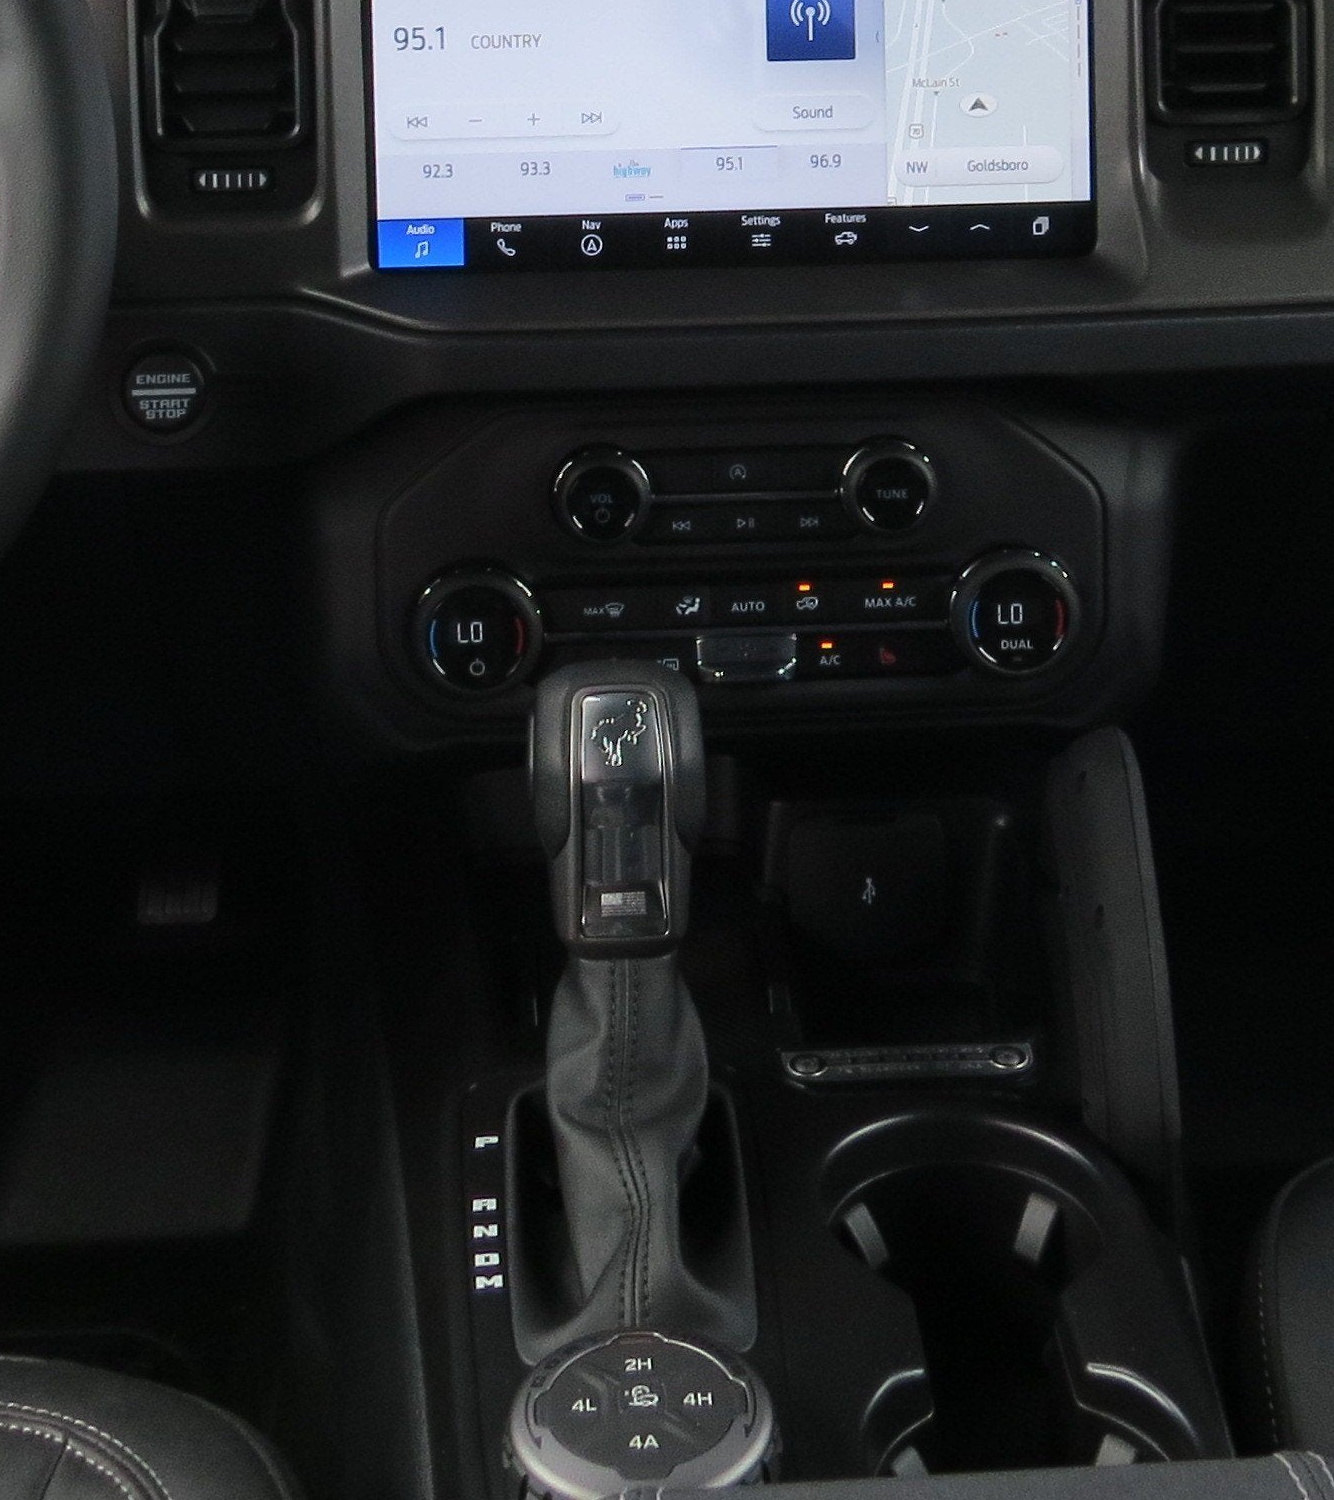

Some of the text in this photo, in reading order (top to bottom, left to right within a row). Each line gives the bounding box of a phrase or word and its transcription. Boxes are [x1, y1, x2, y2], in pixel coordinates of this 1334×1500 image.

[393, 25, 542, 52] 95.1 COUNTRY
[791, 105, 834, 120] Sound
[716, 156, 744, 172] 95.1
[809, 154, 842, 169] 96.9
[905, 160, 929, 175] NW
[966, 159, 1029, 173] Goldsboro
[422, 164, 454, 180] 92.3
[520, 161, 552, 177] 93.3
[581, 219, 601, 231] Nav
[663, 217, 689, 231] Apps
[740, 214, 782, 228] Settings
[824, 212, 867, 225] Features
[405, 223, 436, 236] Audio
[490, 221, 522, 233] Phone
[135, 372, 192, 385] ENGINE
[139, 398, 191, 410] START
[145, 408, 187, 420] STOP
[874, 487, 910, 500] TUNE
[730, 601, 766, 612] AUTO
[864, 595, 918, 609] MAX A/C
[583, 606, 605, 616] MAX
[999, 637, 1035, 651] DUAL
[819, 654, 842, 667] A/C
[474, 1135, 499, 1149] P
[472, 1223, 499, 1239] N
[475, 1274, 504, 1290] M
[623, 1357, 652, 1372] 2H
[571, 1398, 597, 1413] 4L
[682, 1391, 713, 1407] 4H
[628, 1434, 659, 1450] 4A
